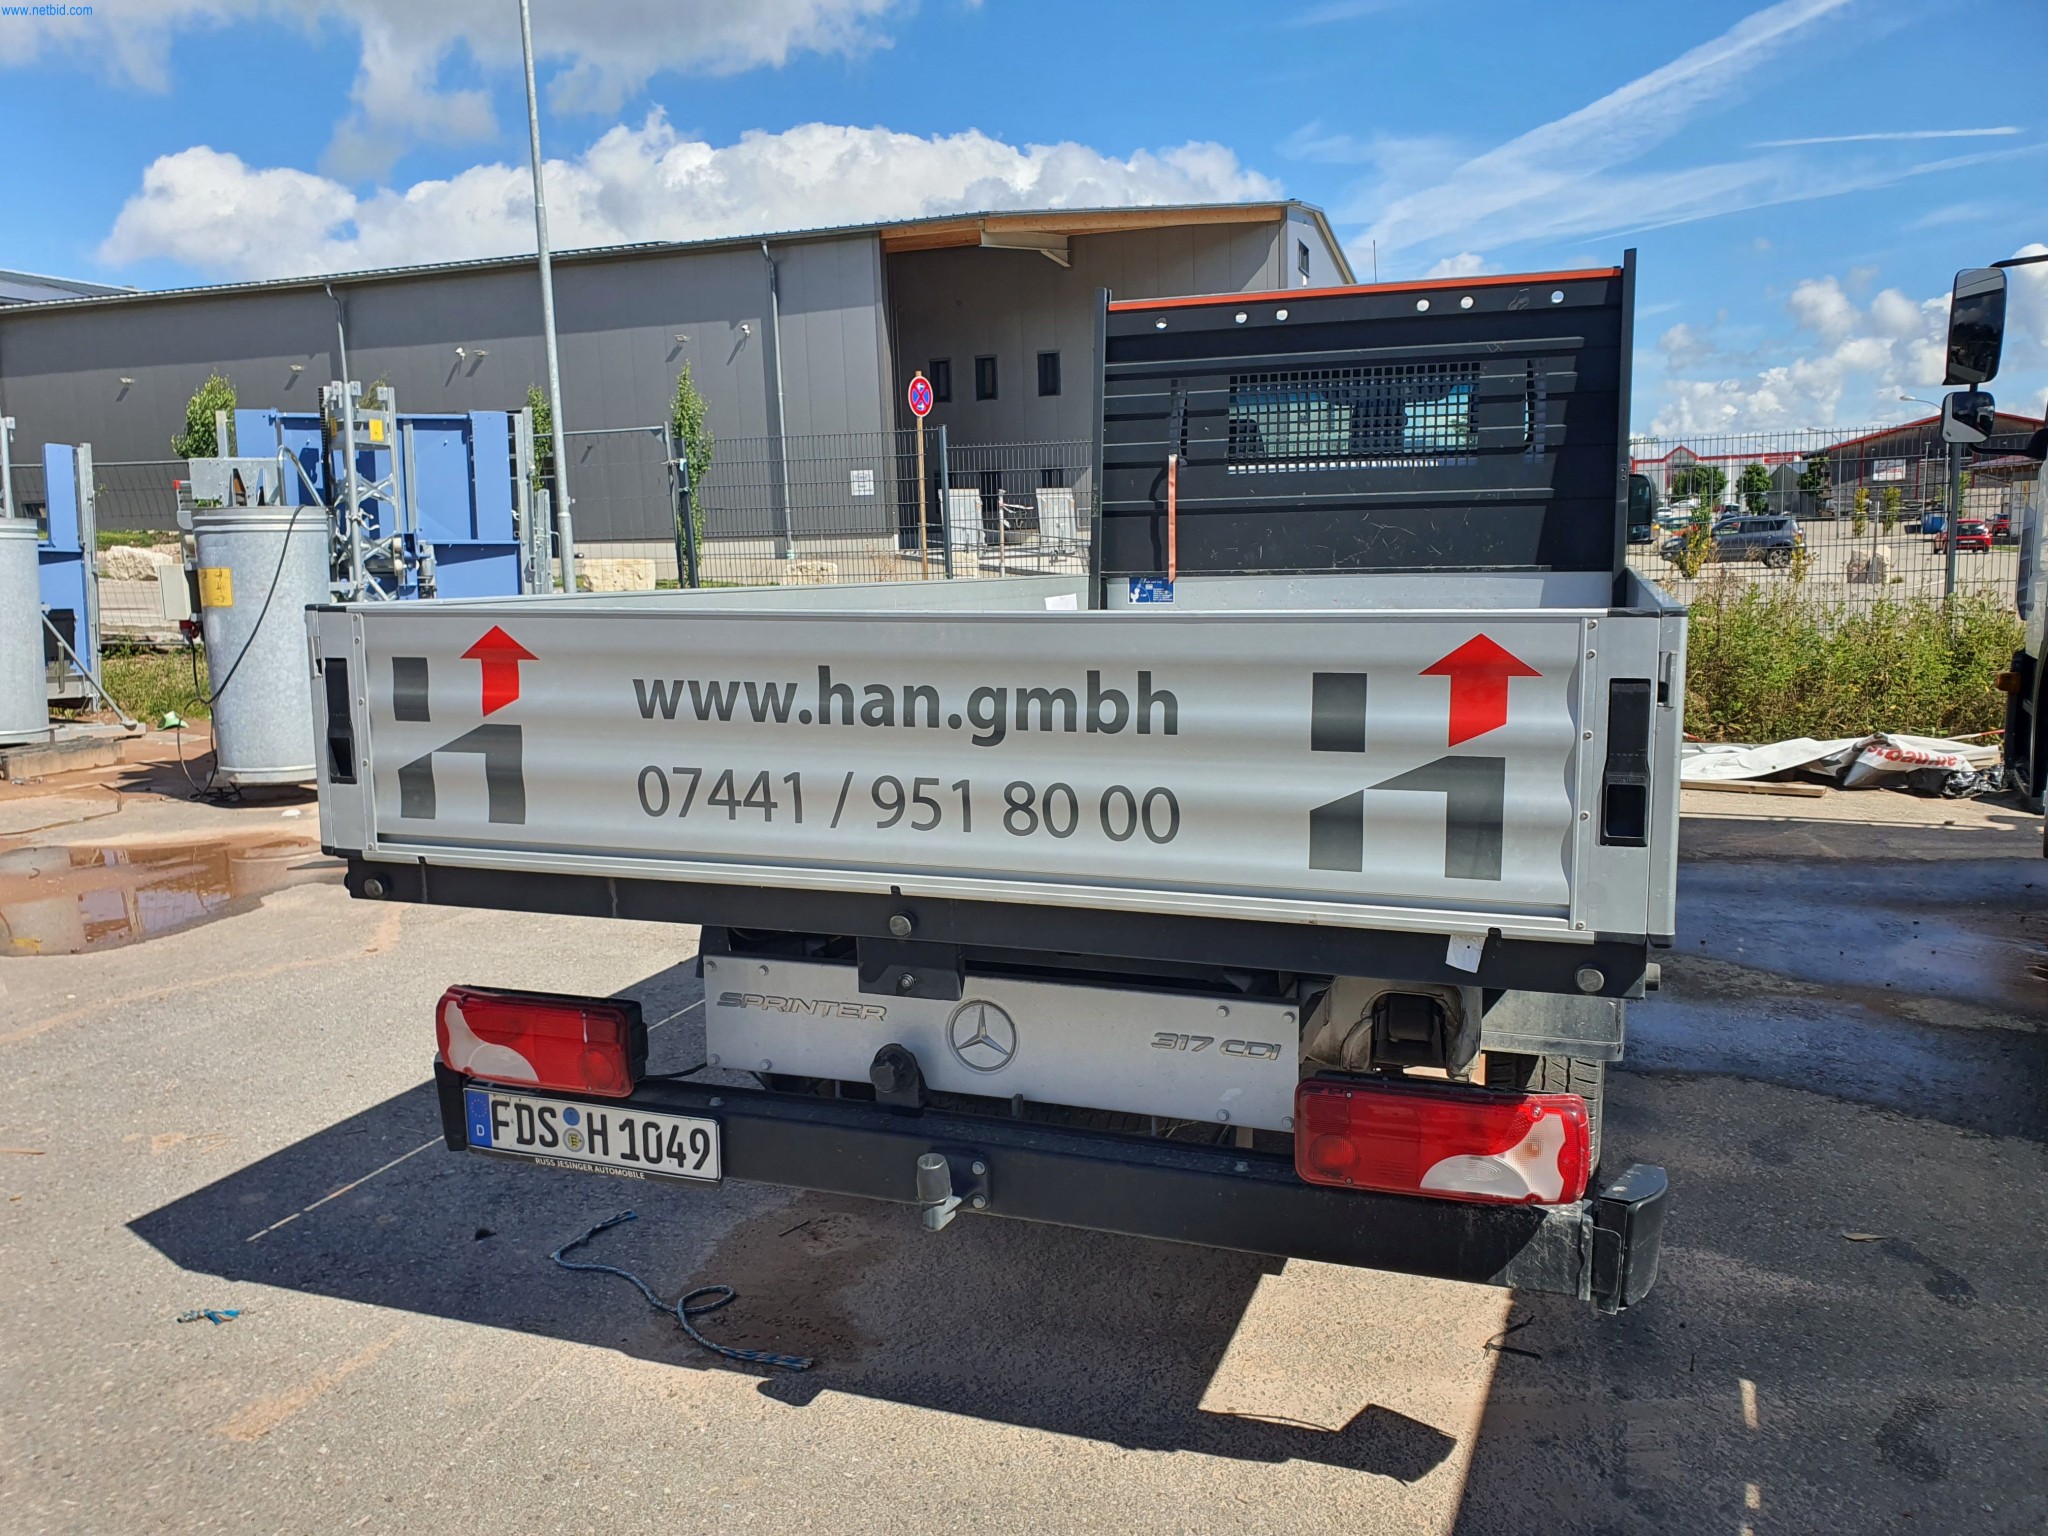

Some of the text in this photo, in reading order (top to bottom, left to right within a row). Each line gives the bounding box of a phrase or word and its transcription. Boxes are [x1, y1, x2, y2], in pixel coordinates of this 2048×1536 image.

[632, 665, 1179, 747] www.han.gmbh
[637, 765, 1180, 844] 07441 / 951 80 00
[717, 991, 888, 1022] SPRINTER
[1150, 1032, 1282, 1061] 317 CDI
[476, 1124, 485, 1137] D
[491, 1099, 711, 1170] FDS H 1049
[535, 1157, 646, 1180] RUSS JESINGER AUTOMOBILE
